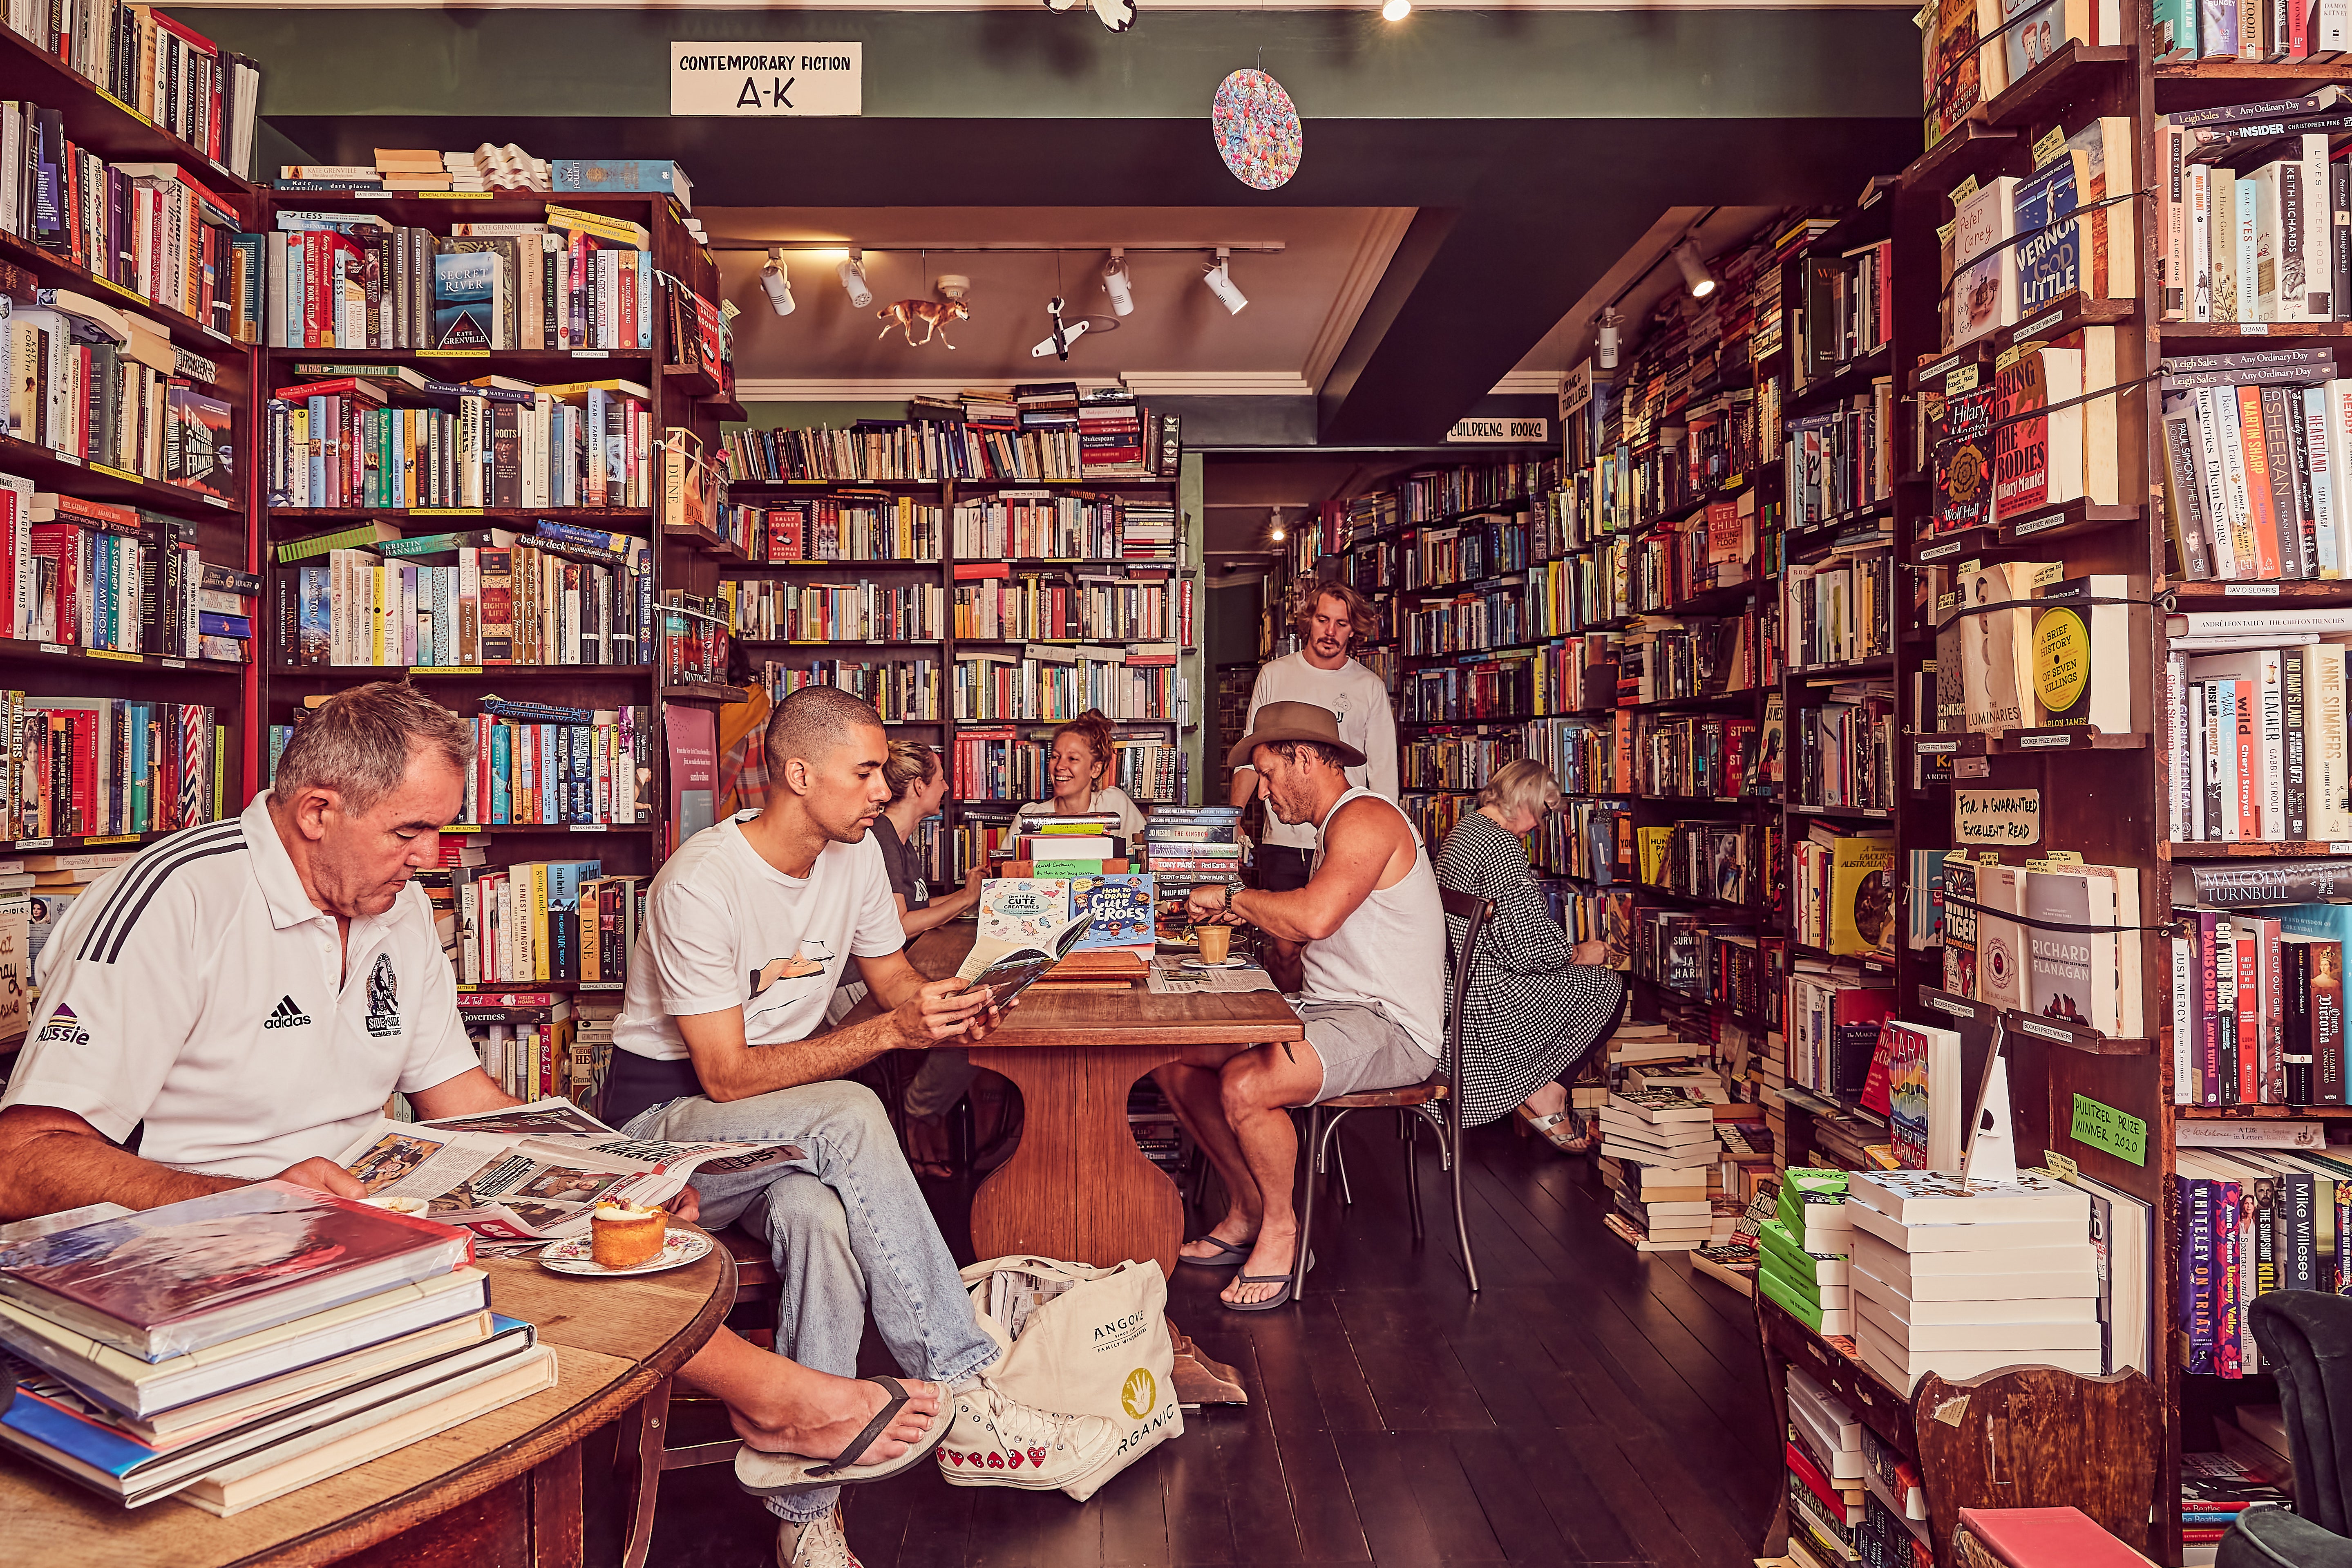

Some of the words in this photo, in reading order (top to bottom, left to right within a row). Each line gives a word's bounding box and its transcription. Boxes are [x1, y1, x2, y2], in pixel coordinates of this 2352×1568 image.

[680, 56, 795, 70] CONTEMPORARY
[802, 56, 850, 70] FICTION
[737, 77, 795, 108] A-K
[1945, 83, 1978, 117] FAMISHED
[1953, 102, 1970, 122] ROAD
[2180, 115, 2199, 125] Leigh
[2200, 112, 2219, 121] Sales
[2240, 106, 2254, 116] Any
[2254, 101, 2283, 114] Ordinary
[2285, 101, 2300, 110] Day
[2239, 125, 2285, 138] INSIDER
[2288, 121, 2325, 130] CHRISTOPHER
[2286, 168, 2295, 195] KEITH
[1960, 208, 1983, 232] Peter
[2243, 219, 2252, 241] YES
[2287, 197, 2297, 253] RICHARDS
[1965, 227, 1993, 253] Carey
[440, 268, 488, 280] SECRET
[2034, 244, 2073, 283] GOD
[445, 280, 483, 292] RIVER
[2023, 265, 2075, 305] LITTLE
[2014, 330, 2030, 340] BOOKER
[2030, 322, 2042, 333] PRIZE
[2042, 313, 2061, 327] WINNERS
[334, 366, 366, 374] TRANSCENDENT
[367, 366, 388, 375] KINGDOM
[1451, 422, 1503, 436] CHILDRENS
[1511, 422, 1542, 437] BOOKS
[2243, 401, 2255, 435] MARTIN
[495, 429, 516, 438] ROOTS
[2309, 415, 2327, 472] HEARTLAND
[2248, 436, 2264, 474] SHARP
[668, 464, 677, 504] DUNE
[1998, 481, 2017, 500] Hilary
[2018, 469, 2044, 494] Mantel
[1710, 519, 1741, 531] CHILD
[1717, 511, 1734, 520] LEE
[521, 534, 545, 547] below
[546, 539, 566, 551] deck
[570, 546, 586, 554] sophie
[585, 548, 613, 558] hardcastle
[1715, 531, 1739, 540] KILLING
[310, 570, 318, 618] HAMILTON
[99, 588, 107, 634] MYTHOS
[2201, 619, 2223, 627] ANDRÉ
[2041, 636, 2045, 644] A
[2047, 624, 2068, 640] BRIEF
[2041, 635, 2071, 658] HISTORY
[2042, 668, 2051, 682] OF
[2052, 660, 2077, 677] SEVEN
[2044, 673, 2077, 694] KILLINGS
[2321, 657, 2339, 691] ANNE
[1969, 707, 2019, 727] LUMINARIES
[2238, 697, 2250, 735] wild
[2322, 695, 2341, 759] SUMMERS
[13, 705, 22, 758] MOTHERS
[2241, 744, 2249, 777] Cheryl
[1167, 772, 1175, 798] WELSH
[2240, 779, 2251, 817] Strayed
[1960, 795, 1978, 815] FOR
[1983, 799, 1988, 813] A
[1991, 796, 2037, 814] GUARANTEED
[1963, 821, 2004, 837] EXCELLENT
[2008, 822, 2029, 839] READ
[2205, 871, 2287, 887] MALCOLM
[1091, 894, 1129, 908] Cute
[2206, 886, 2288, 901] TURNBULL
[1084, 908, 1146, 923] HEROES
[1946, 913, 1975, 942] TIGER
[2032, 939, 2089, 962] RICHARD
[2033, 959, 2089, 981] FLANAGAN
[264, 1014, 311, 1029] adidas
[368, 1018, 384, 1028] SIDE
[387, 1017, 400, 1027] SIDE
[35, 1026, 89, 1045] Aussie
[1890, 1029, 1928, 1068] TARA
[2075, 1097, 2111, 1123] PULITZER
[2118, 1115, 2139, 1134] PRIZE
[2076, 1121, 2108, 1141] WINNER
[2115, 1134, 2137, 1152] 2020
[1892, 1139, 1926, 1169] CARNAGE
[2296, 1183, 2307, 1218] Mike
[2194, 1188, 2208, 1262] WHITELEY
[2296, 1221, 2308, 1281] Willesee
[2196, 1268, 2208, 1287] ON
[2196, 1291, 2208, 1334] TRIAL
[1094, 1310, 1144, 1342] ANGOVE
[1098, 1342, 1120, 1353] FAMILY
[1122, 1327, 1147, 1345] WINEMAKERS
[1117, 1404, 1174, 1456] RGANIC
